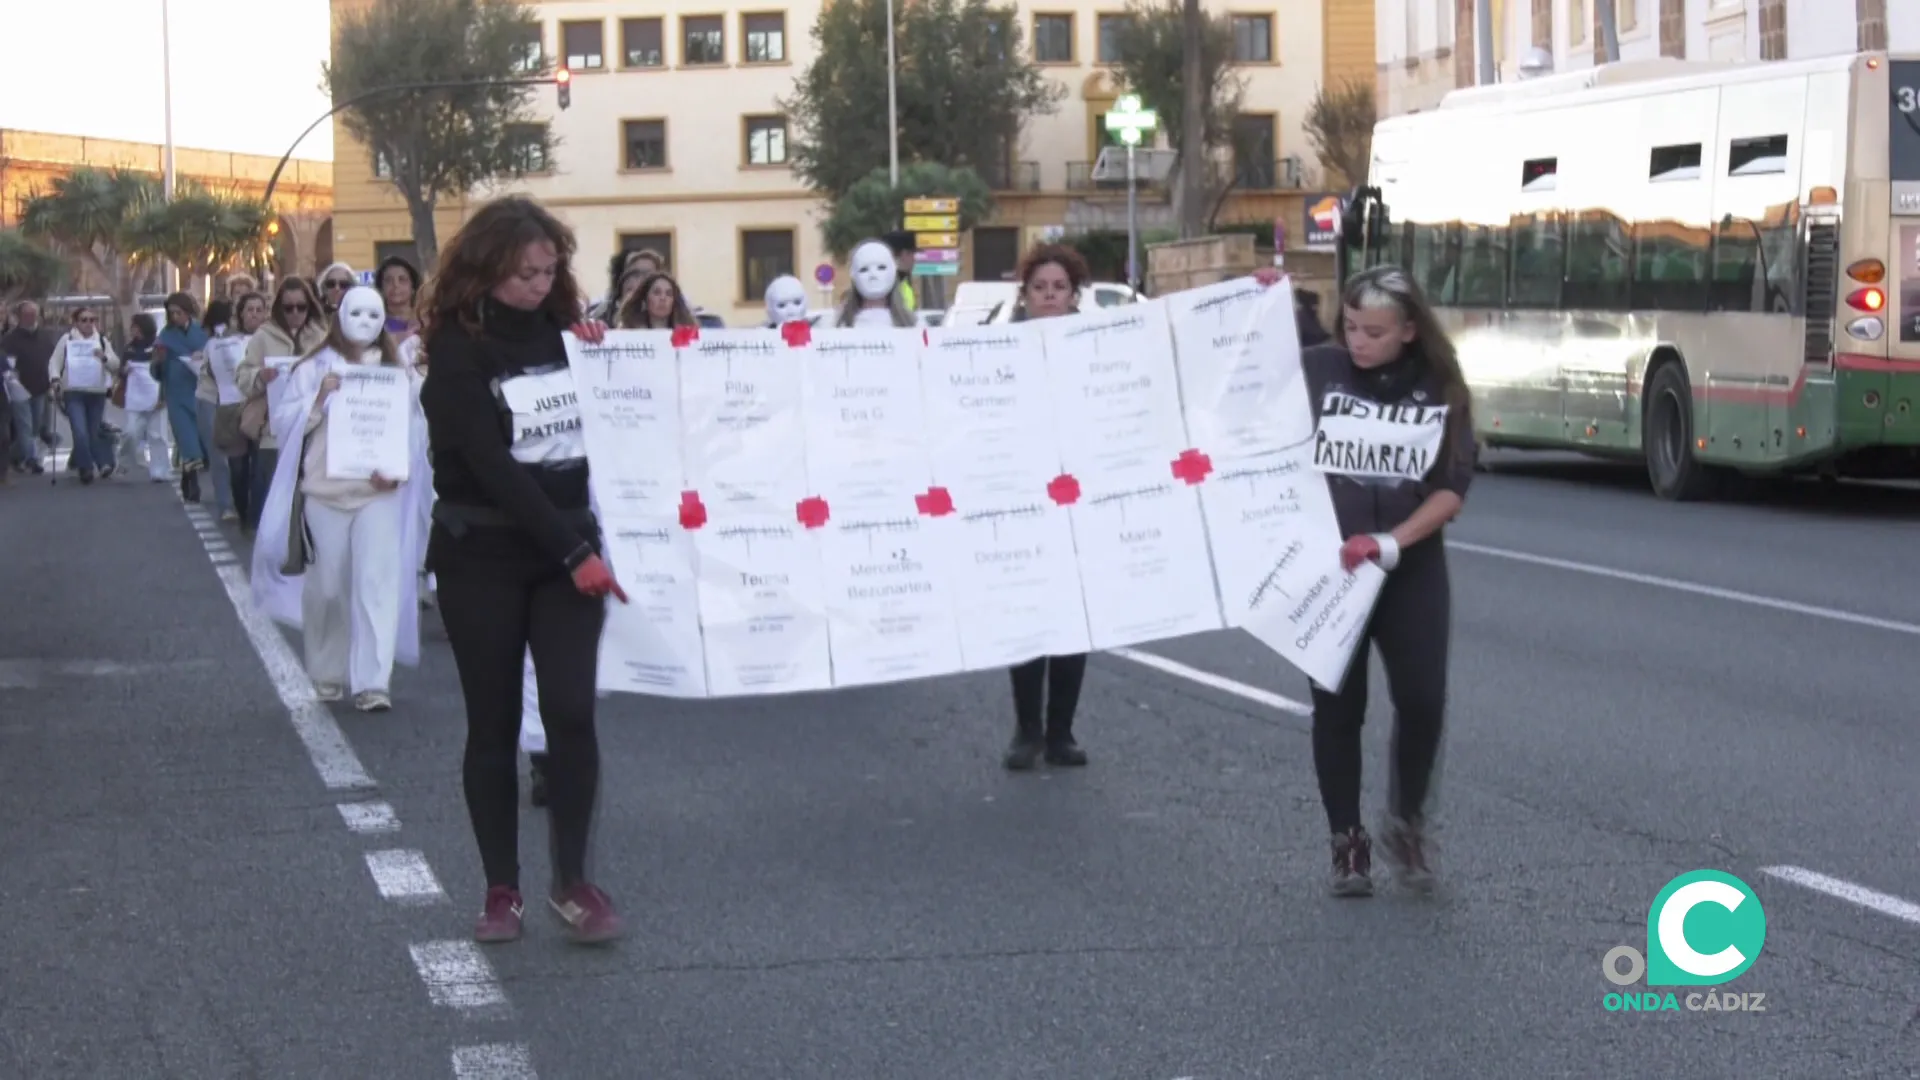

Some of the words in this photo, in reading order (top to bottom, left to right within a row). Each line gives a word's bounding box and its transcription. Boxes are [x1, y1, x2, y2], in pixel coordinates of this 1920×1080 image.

[1898, 86, 1920, 113] 3
[592, 385, 653, 401] Carmelita
[724, 380, 755, 395] Pilar
[1287, 574, 1331, 625] Nombre
